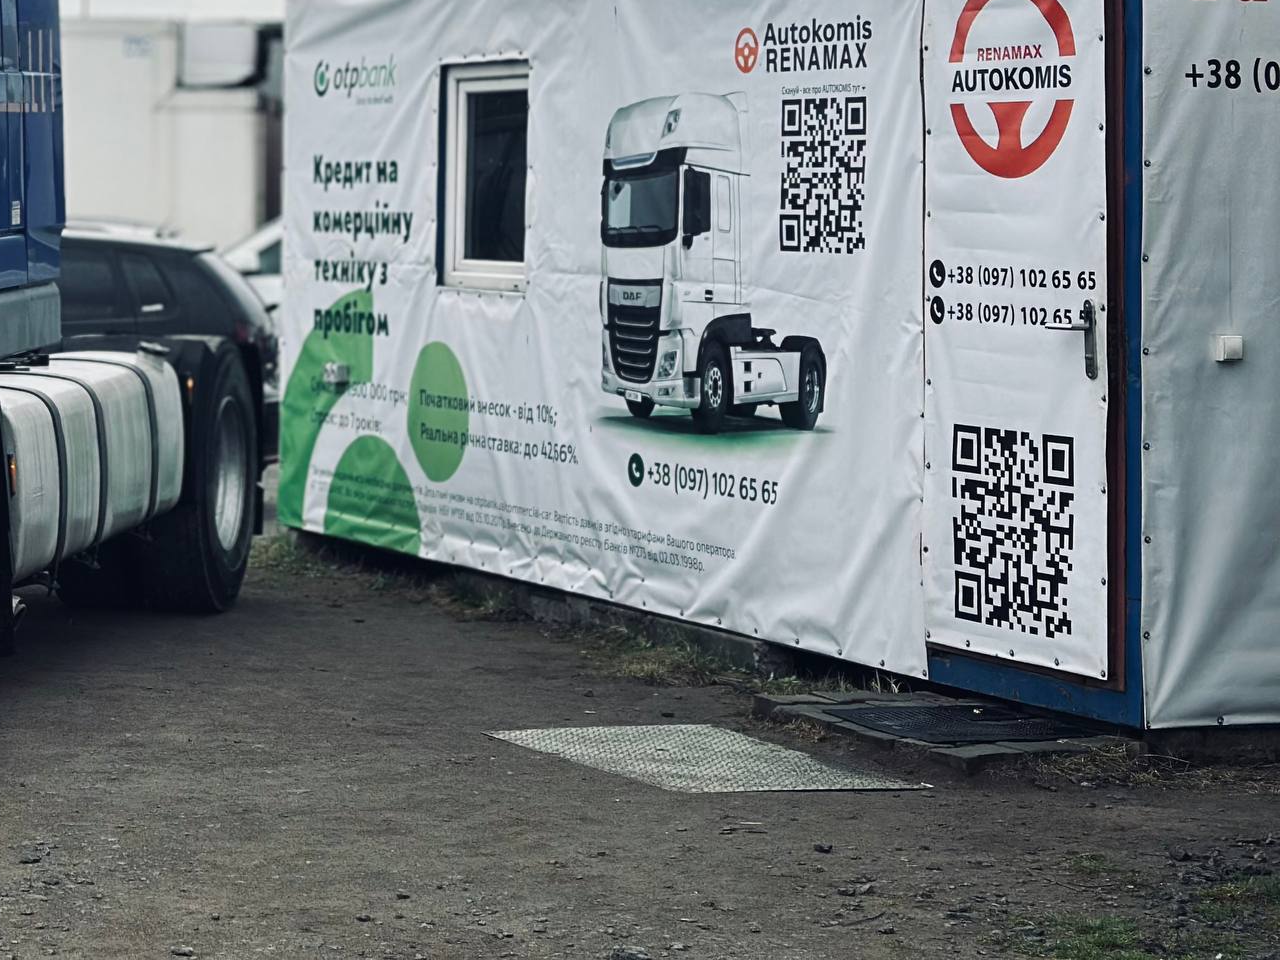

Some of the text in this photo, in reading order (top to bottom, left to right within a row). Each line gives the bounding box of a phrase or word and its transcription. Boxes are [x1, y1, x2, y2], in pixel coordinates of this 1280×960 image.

[763, 14, 872, 46] Autokomis
[766, 42, 868, 73] RENAMAX
[977, 44, 1043, 62] RENAMAX
[951, 64, 1072, 93] AUTOKOMIS
[1185, 58, 1241, 89] +38
[313, 154, 398, 192] Кредит на
[313, 200, 413, 244] комерційну
[314, 251, 377, 292] техніку
[947, 265, 1096, 290] +38 (097) 102 65 65
[313, 300, 389, 339] пробігом
[947, 303, 973, 321] +38
[978, 302, 1015, 326] (097)
[1020, 306, 1048, 326] 102
[1053, 308, 1072, 324] 65
[419, 389, 476, 412] Початковий
[477, 400, 511, 418] внесок
[518, 402, 534, 424] від
[536, 404, 558, 427] 10%;
[524, 443, 539, 459] до
[647, 462, 779, 505] +38 (097) 102 65 65
[666, 534, 695, 551] Вашого
